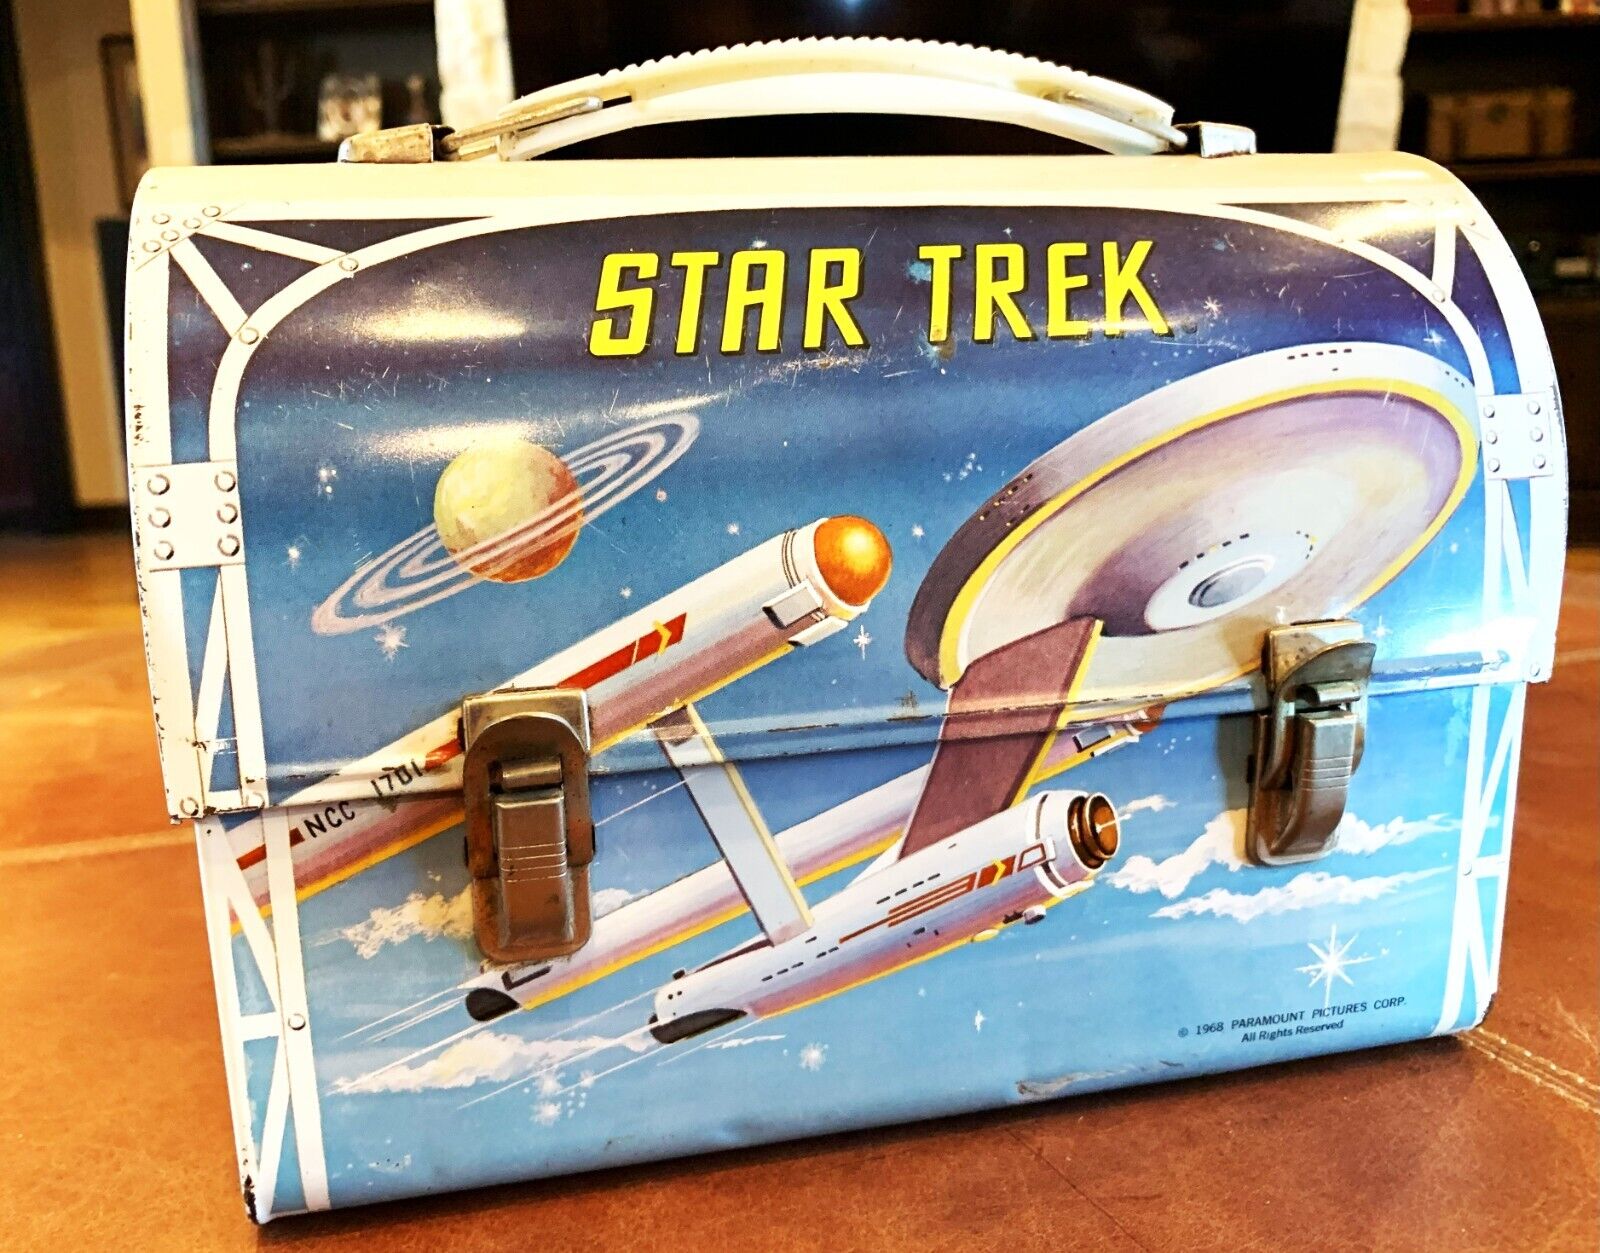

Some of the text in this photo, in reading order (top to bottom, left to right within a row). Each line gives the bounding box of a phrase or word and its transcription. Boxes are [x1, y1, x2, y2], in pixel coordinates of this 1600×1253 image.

[588, 239, 1176, 357] STAR TREK
[303, 758, 424, 838] NCC 1701
[1196, 1021, 1225, 1036] 1968
[1231, 1010, 1305, 1030] PARAMOUNT
[1311, 1001, 1368, 1020] PICTURES
[1373, 996, 1408, 1011] CORP.
[1241, 1019, 1345, 1043] All Rights Reserved
